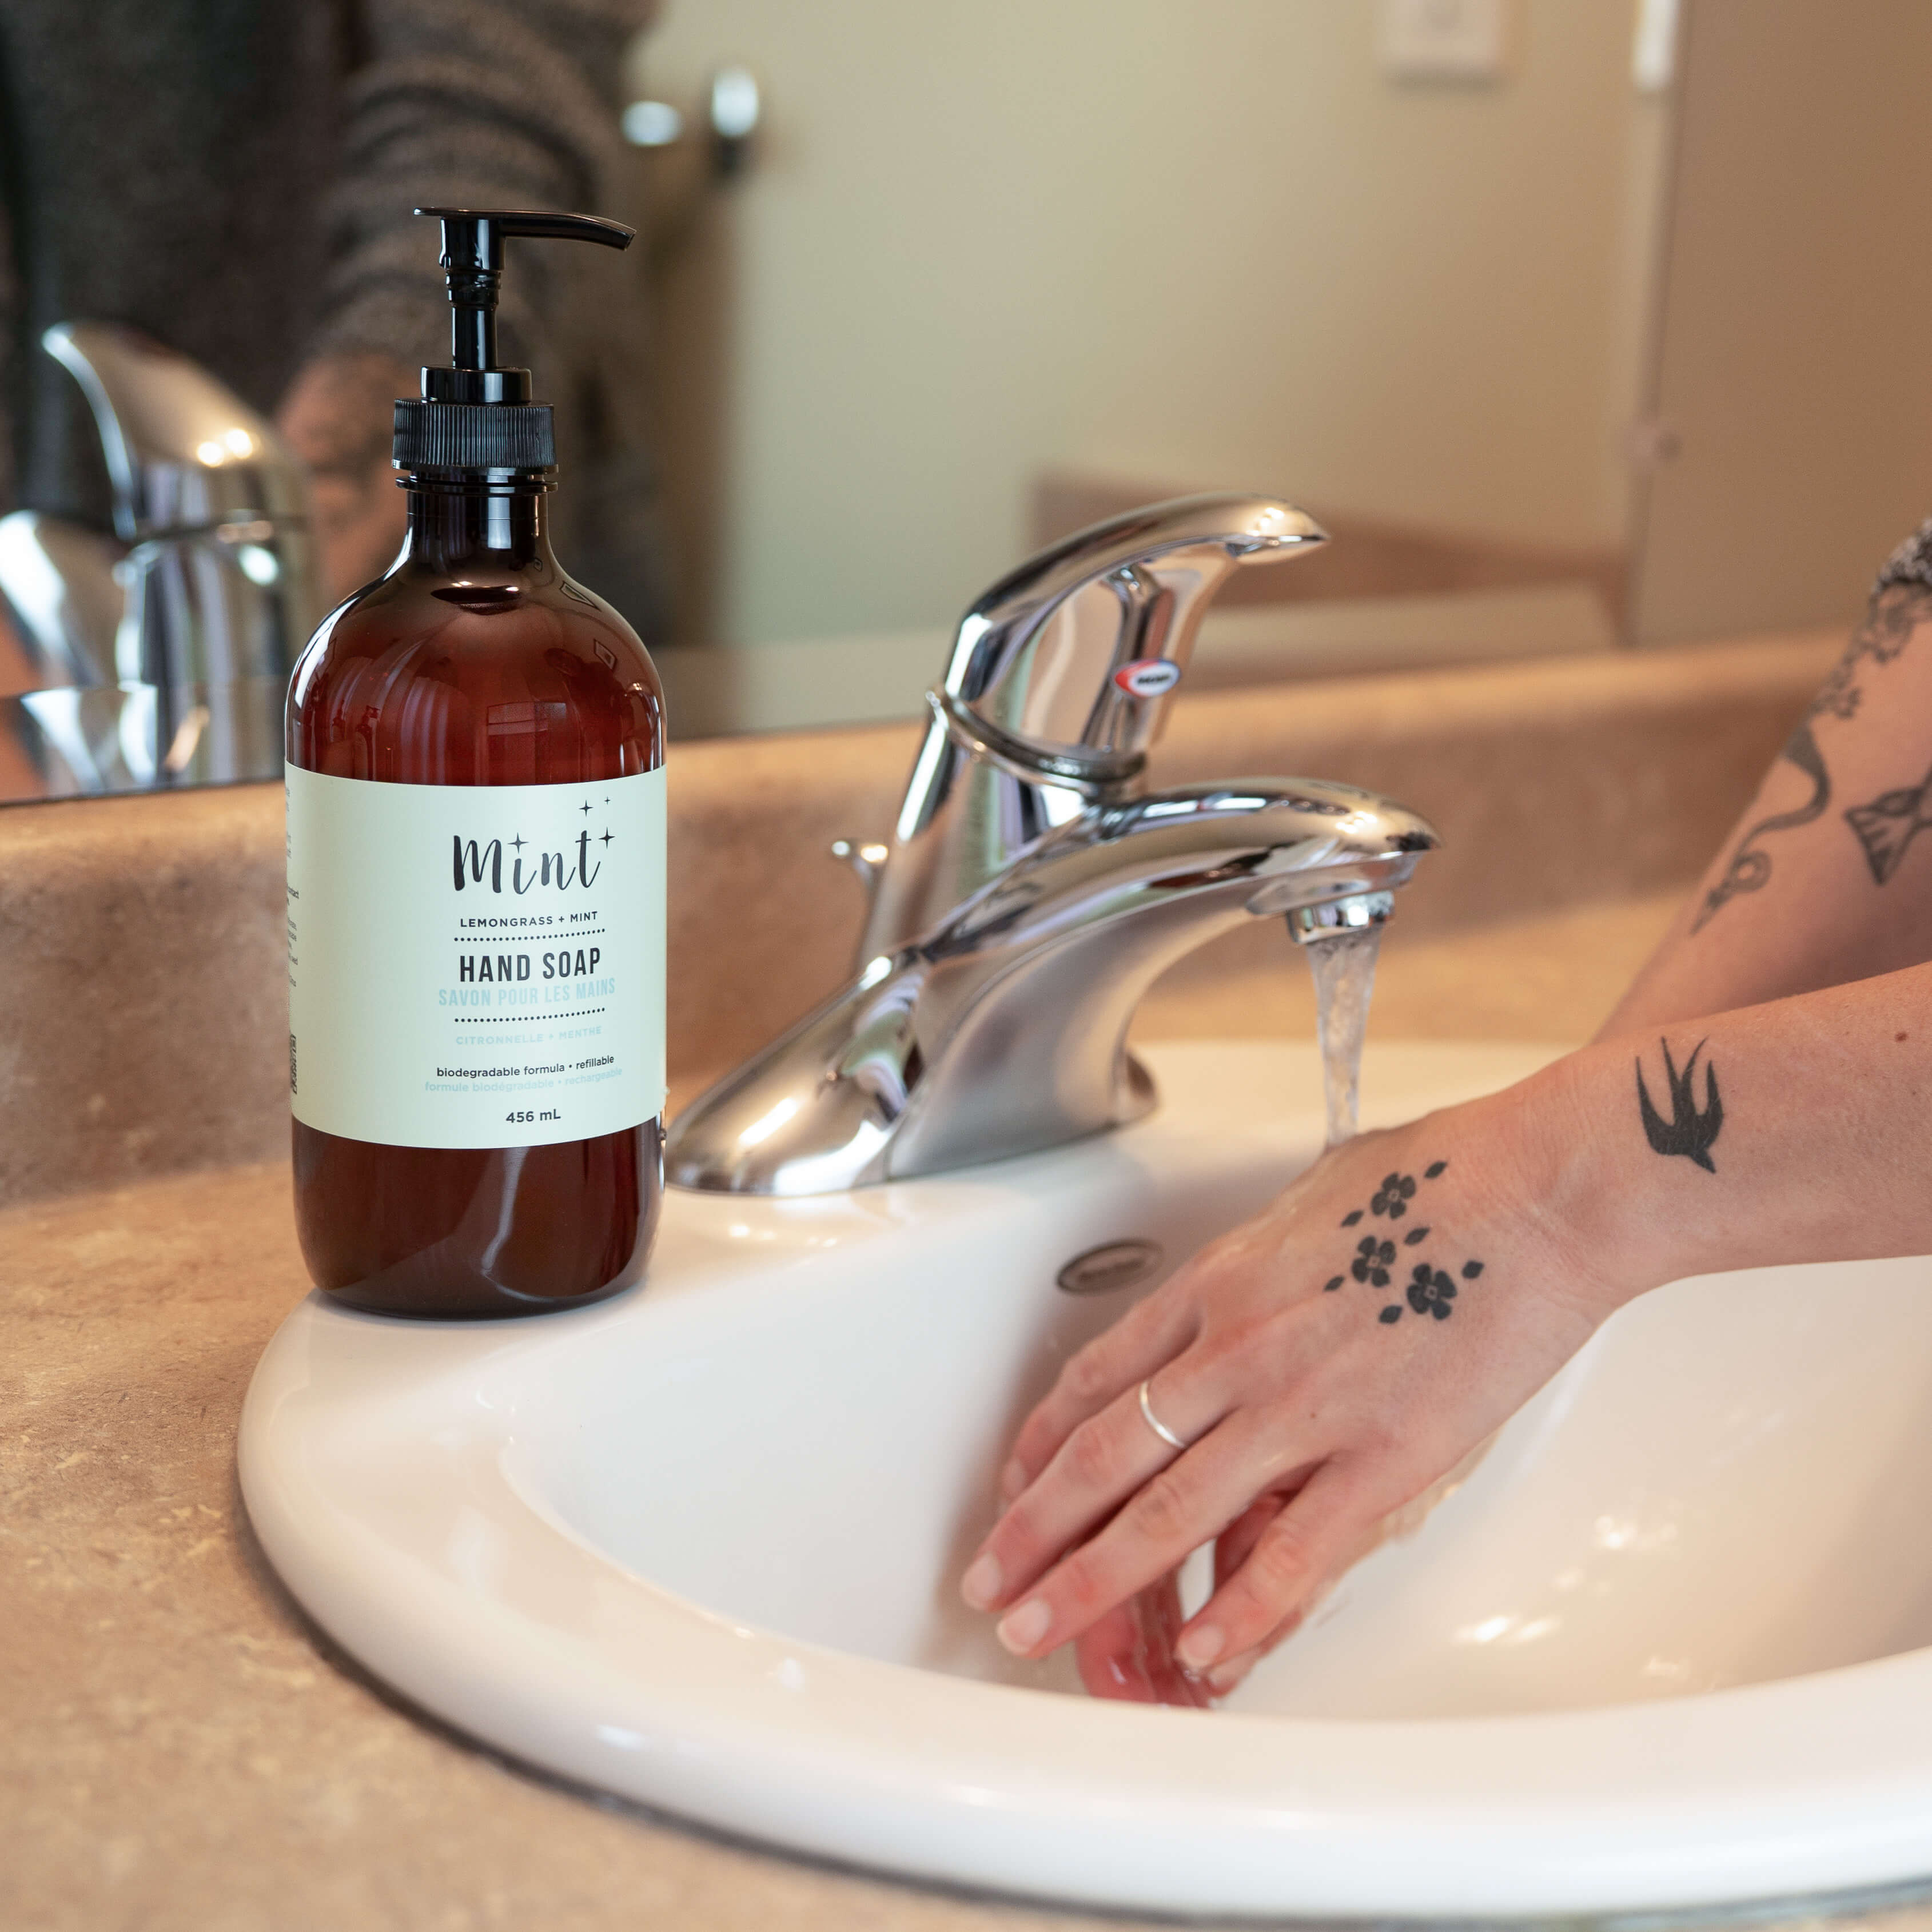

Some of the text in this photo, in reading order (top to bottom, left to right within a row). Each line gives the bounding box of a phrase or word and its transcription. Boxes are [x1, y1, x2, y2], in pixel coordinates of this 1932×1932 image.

[453, 830, 600, 895] Mint
[460, 916, 553, 927] LEMONGRASS
[570, 911, 597, 923] MINT
[460, 947, 600, 982] HAND SOAP
[439, 977, 615, 1006] SAVON POUR LES MAINS
[456, 1033, 544, 1045] CITRONNELLE
[559, 1026, 602, 1040] MENTHE
[437, 1055, 615, 1079] biodegradable formula refillable
[425, 1067, 623, 1093] formule biodégradable rechargeable
[505, 1109, 561, 1124] 456 mL
